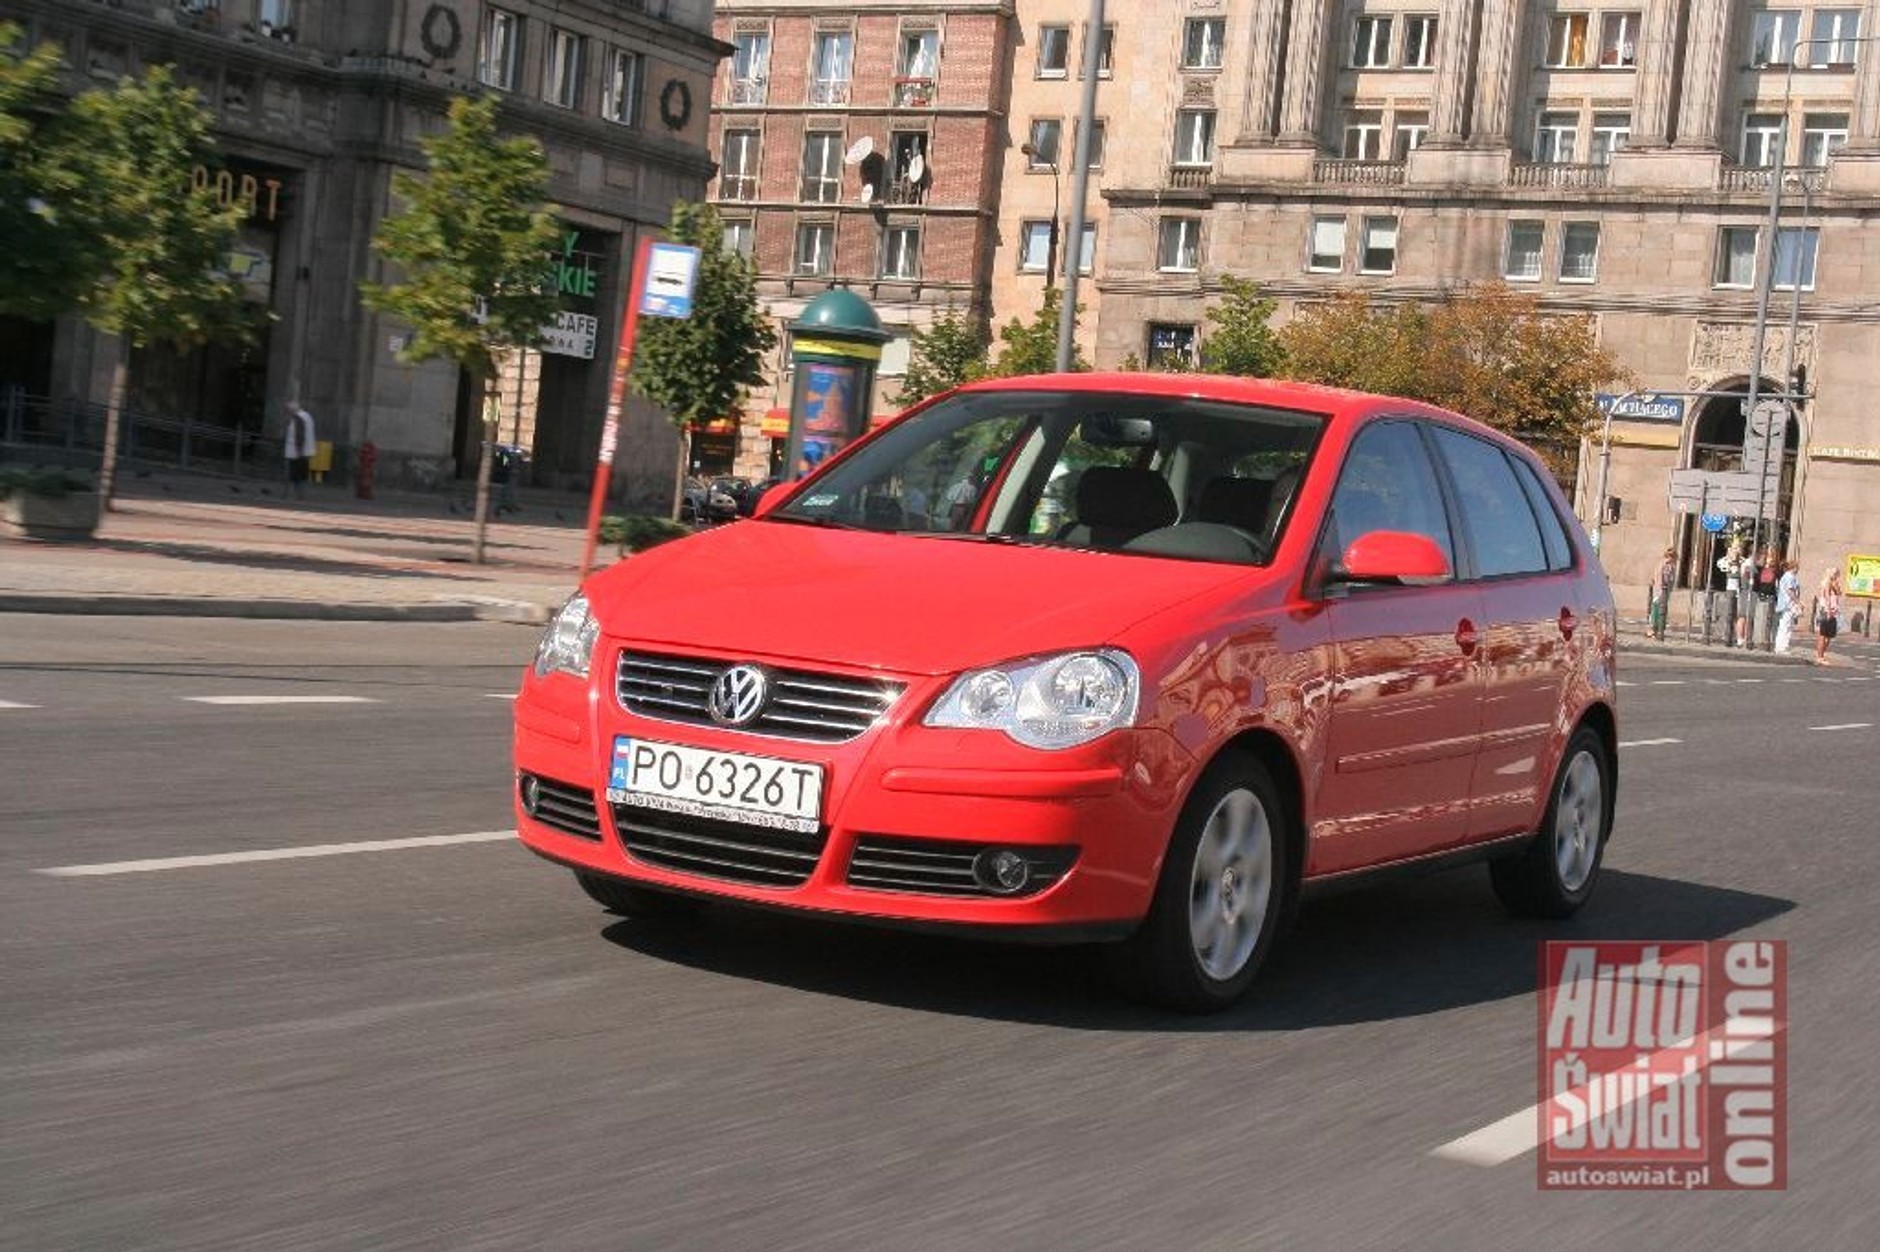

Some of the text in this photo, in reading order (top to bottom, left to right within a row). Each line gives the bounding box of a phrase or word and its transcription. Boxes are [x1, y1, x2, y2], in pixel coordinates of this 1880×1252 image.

[613, 767, 626, 780] PL
[632, 745, 814, 810] PO 6326T
